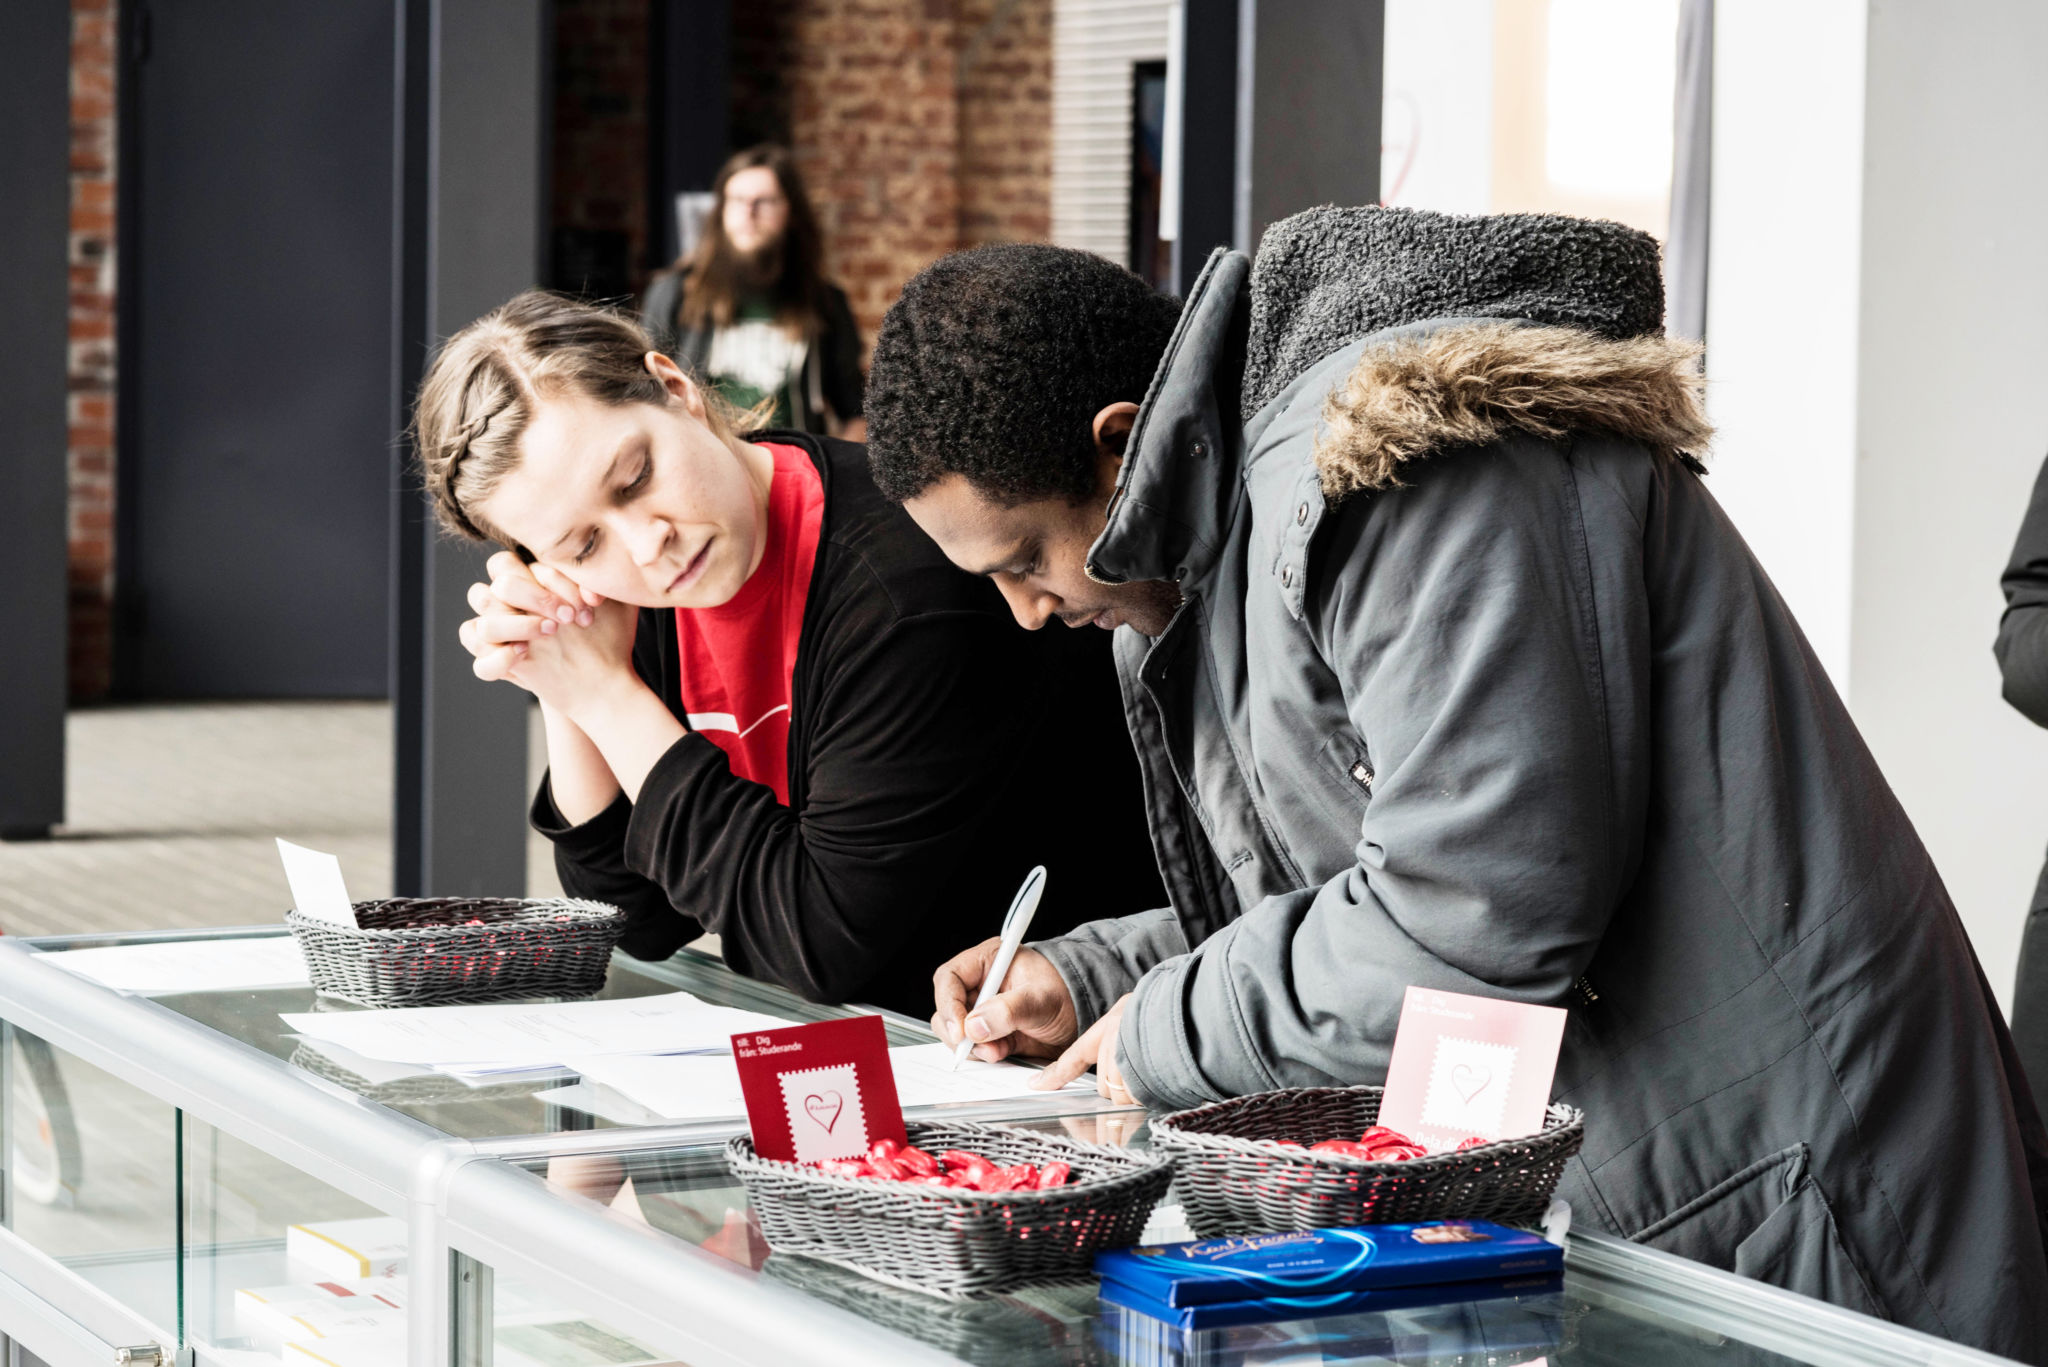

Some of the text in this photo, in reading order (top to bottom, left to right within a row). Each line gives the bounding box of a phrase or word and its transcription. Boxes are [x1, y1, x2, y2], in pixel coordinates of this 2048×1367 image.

[755, 1035, 771, 1046] Dig
[757, 1041, 803, 1056] Studerande
[1415, 1130, 1441, 1149] Dela
